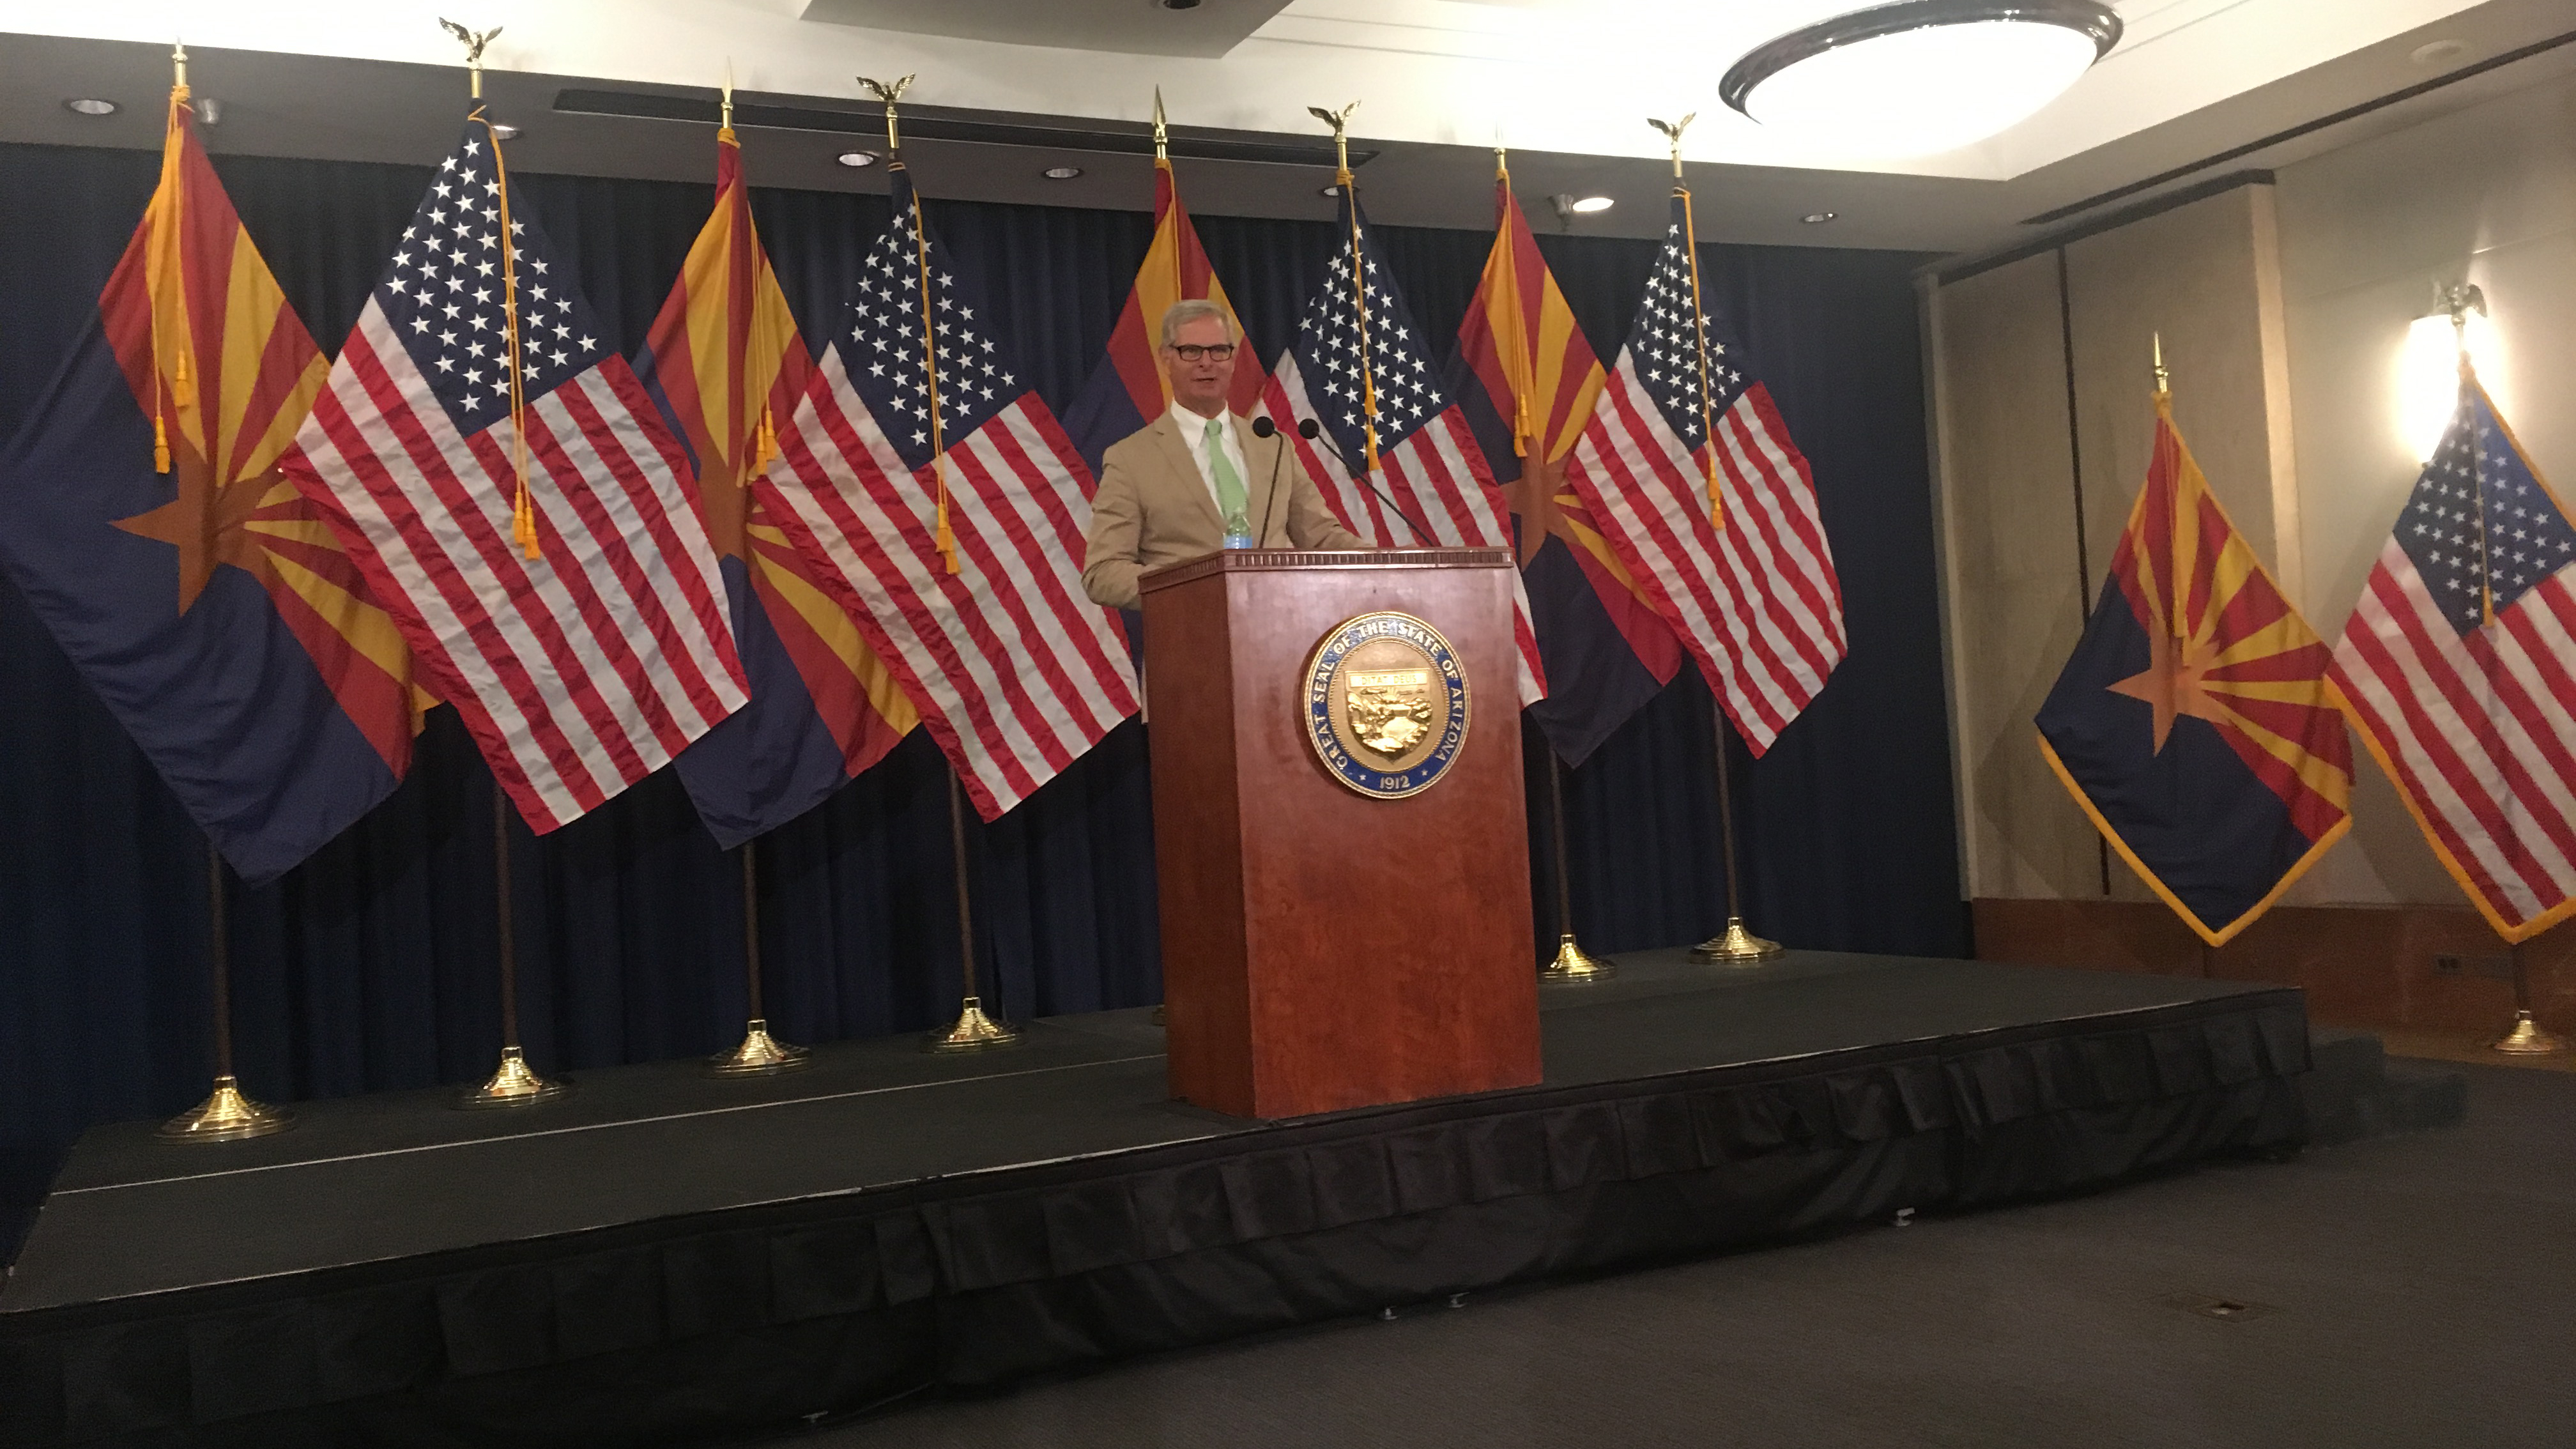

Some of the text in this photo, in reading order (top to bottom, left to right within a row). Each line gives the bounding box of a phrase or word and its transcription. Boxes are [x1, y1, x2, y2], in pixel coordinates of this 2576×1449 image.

[1361, 675, 1417, 685] DITAT DEUS
[1314, 620, 1462, 770] GREAT SEAL OF THE STATE OF ARIZONA
[1380, 775, 1410, 790] 1912
